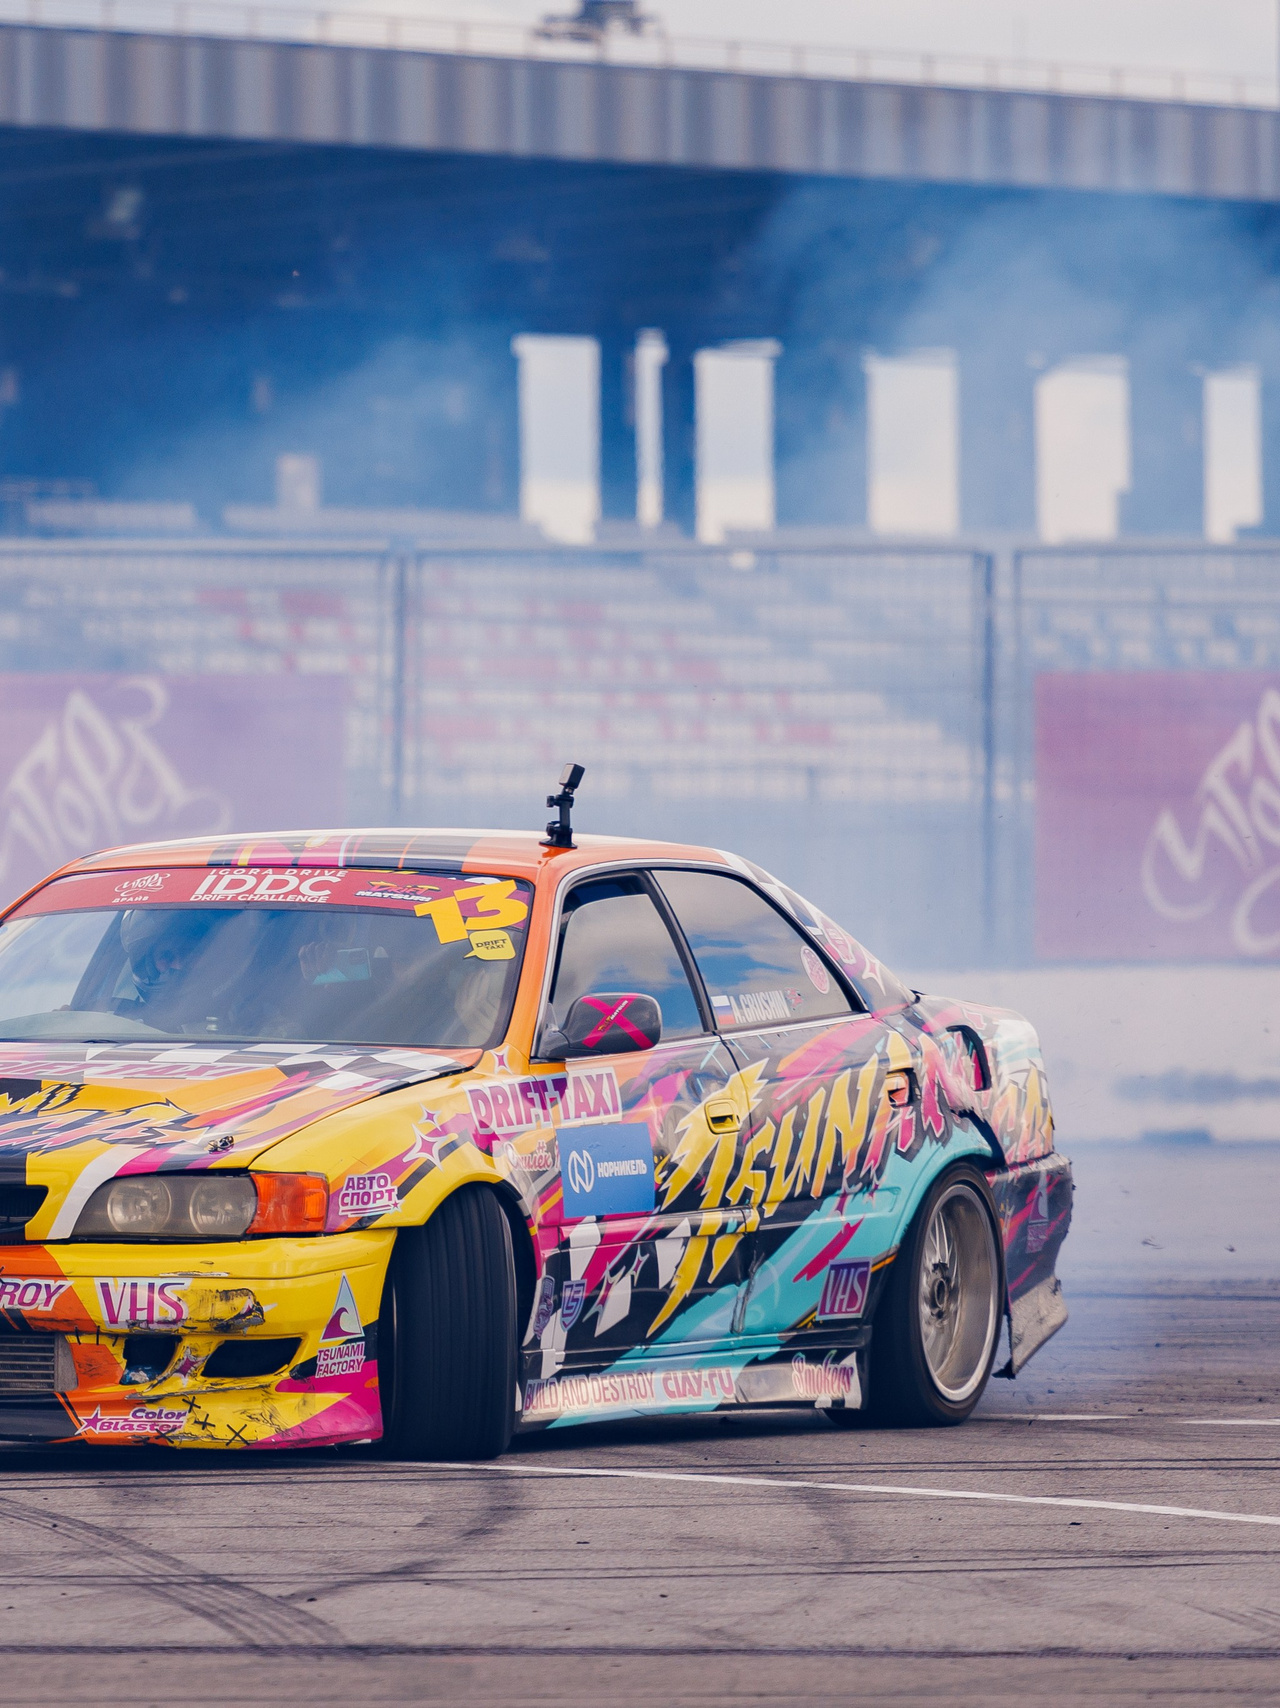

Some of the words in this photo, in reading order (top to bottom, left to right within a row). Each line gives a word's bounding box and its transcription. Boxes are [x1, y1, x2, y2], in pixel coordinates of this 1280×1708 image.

[209, 868, 279, 877] IGORA
[285, 868, 349, 878] DRIVE
[194, 874, 342, 896] IDDC
[190, 894, 239, 902] DRIFT
[239, 893, 330, 903] CHALLENGE
[355, 890, 433, 903] MATSURI
[414, 879, 529, 945] 13
[475, 938, 508, 949] DRIFT
[98, 1063, 263, 1078] TAXI
[467, 1079, 552, 1130] DRIFT
[551, 1072, 621, 1121] TAXI
[596, 1159, 648, 1178] НОРНИКЕЛЬ
[344, 1174, 389, 1192] АВТО
[339, 1187, 397, 1207] СПОРТ
[824, 1266, 868, 1314] VHS
[99, 1281, 188, 1325] VHS
[317, 1342, 365, 1363] TSUNAMI
[316, 1357, 365, 1377] FACTORY
[523, 1378, 558, 1412] BUILD
[561, 1375, 591, 1408] AND
[591, 1370, 657, 1405] DESTROY
[131, 1407, 187, 1421] Color
[99, 1421, 183, 1433] Blaster
